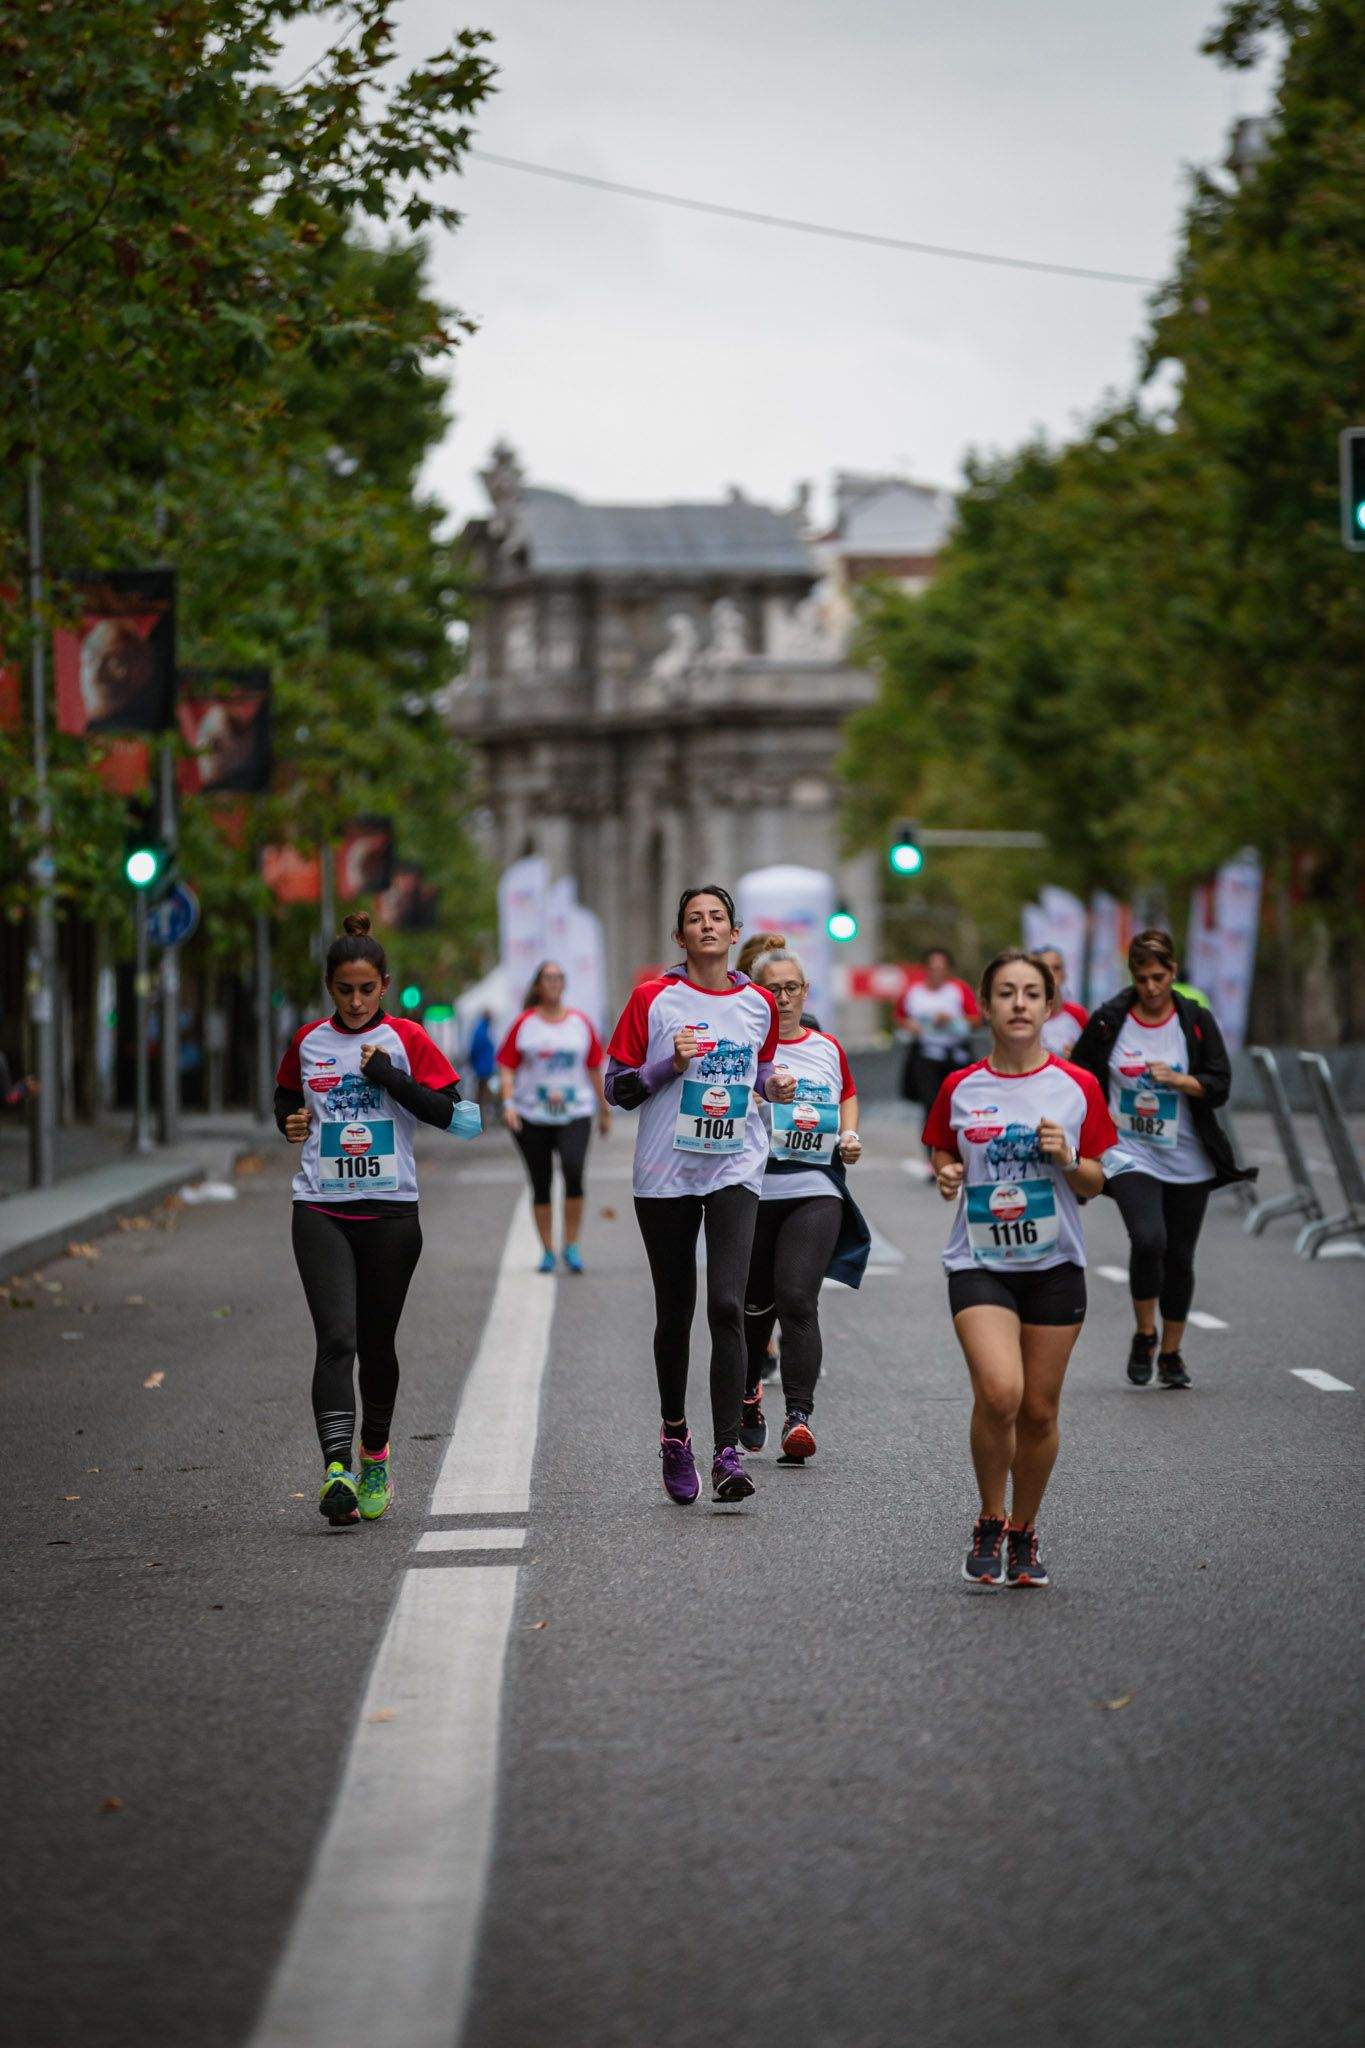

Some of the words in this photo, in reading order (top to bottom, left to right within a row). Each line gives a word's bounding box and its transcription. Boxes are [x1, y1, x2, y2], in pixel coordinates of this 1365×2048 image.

[694, 1118, 734, 1140] 1104
[1130, 1117, 1165, 1137] 1082
[785, 1131, 823, 1151] 1084
[335, 1156, 380, 1179] 1105
[989, 1220, 1038, 1246] 1116
